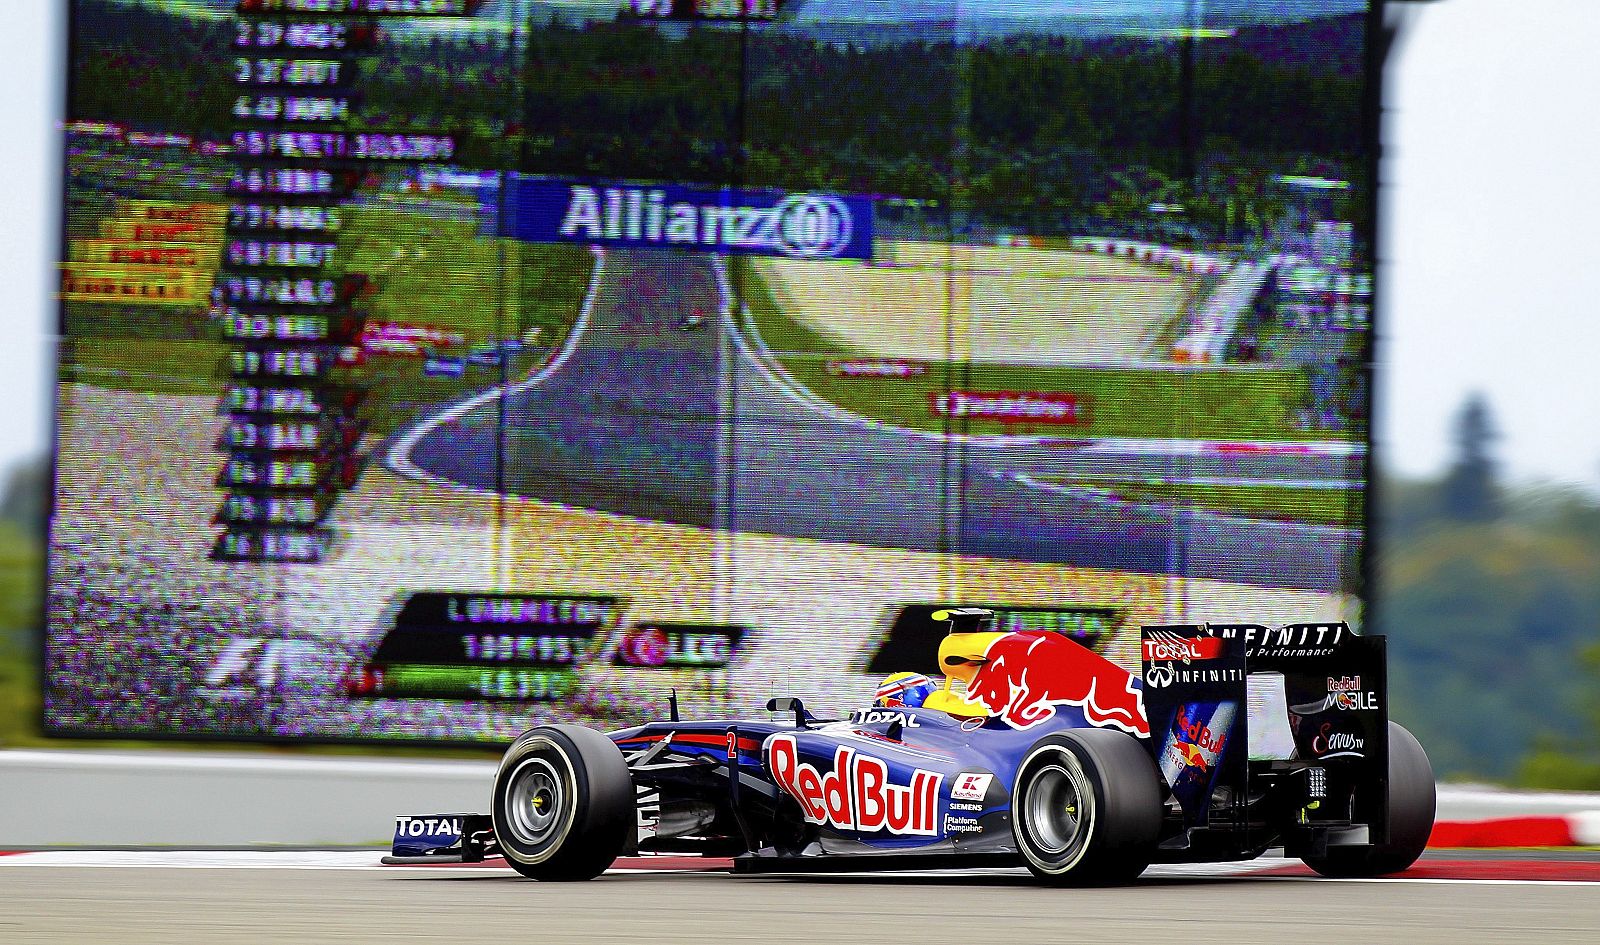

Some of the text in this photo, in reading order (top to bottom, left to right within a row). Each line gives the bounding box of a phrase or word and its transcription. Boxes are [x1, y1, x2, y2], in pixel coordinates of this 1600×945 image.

[560, 185, 782, 247] Allianz
[1144, 639, 1202, 660] TOTAL
[1175, 668, 1243, 683] INFINITI
[856, 707, 922, 729] TOTAL
[726, 731, 737, 759] 2
[1312, 722, 1356, 755] Servus
[949, 802, 983, 812] SIEMENS
[396, 816, 462, 837] TOTAL
[946, 824, 984, 834] Computing
[947, 816, 978, 826] Platform
